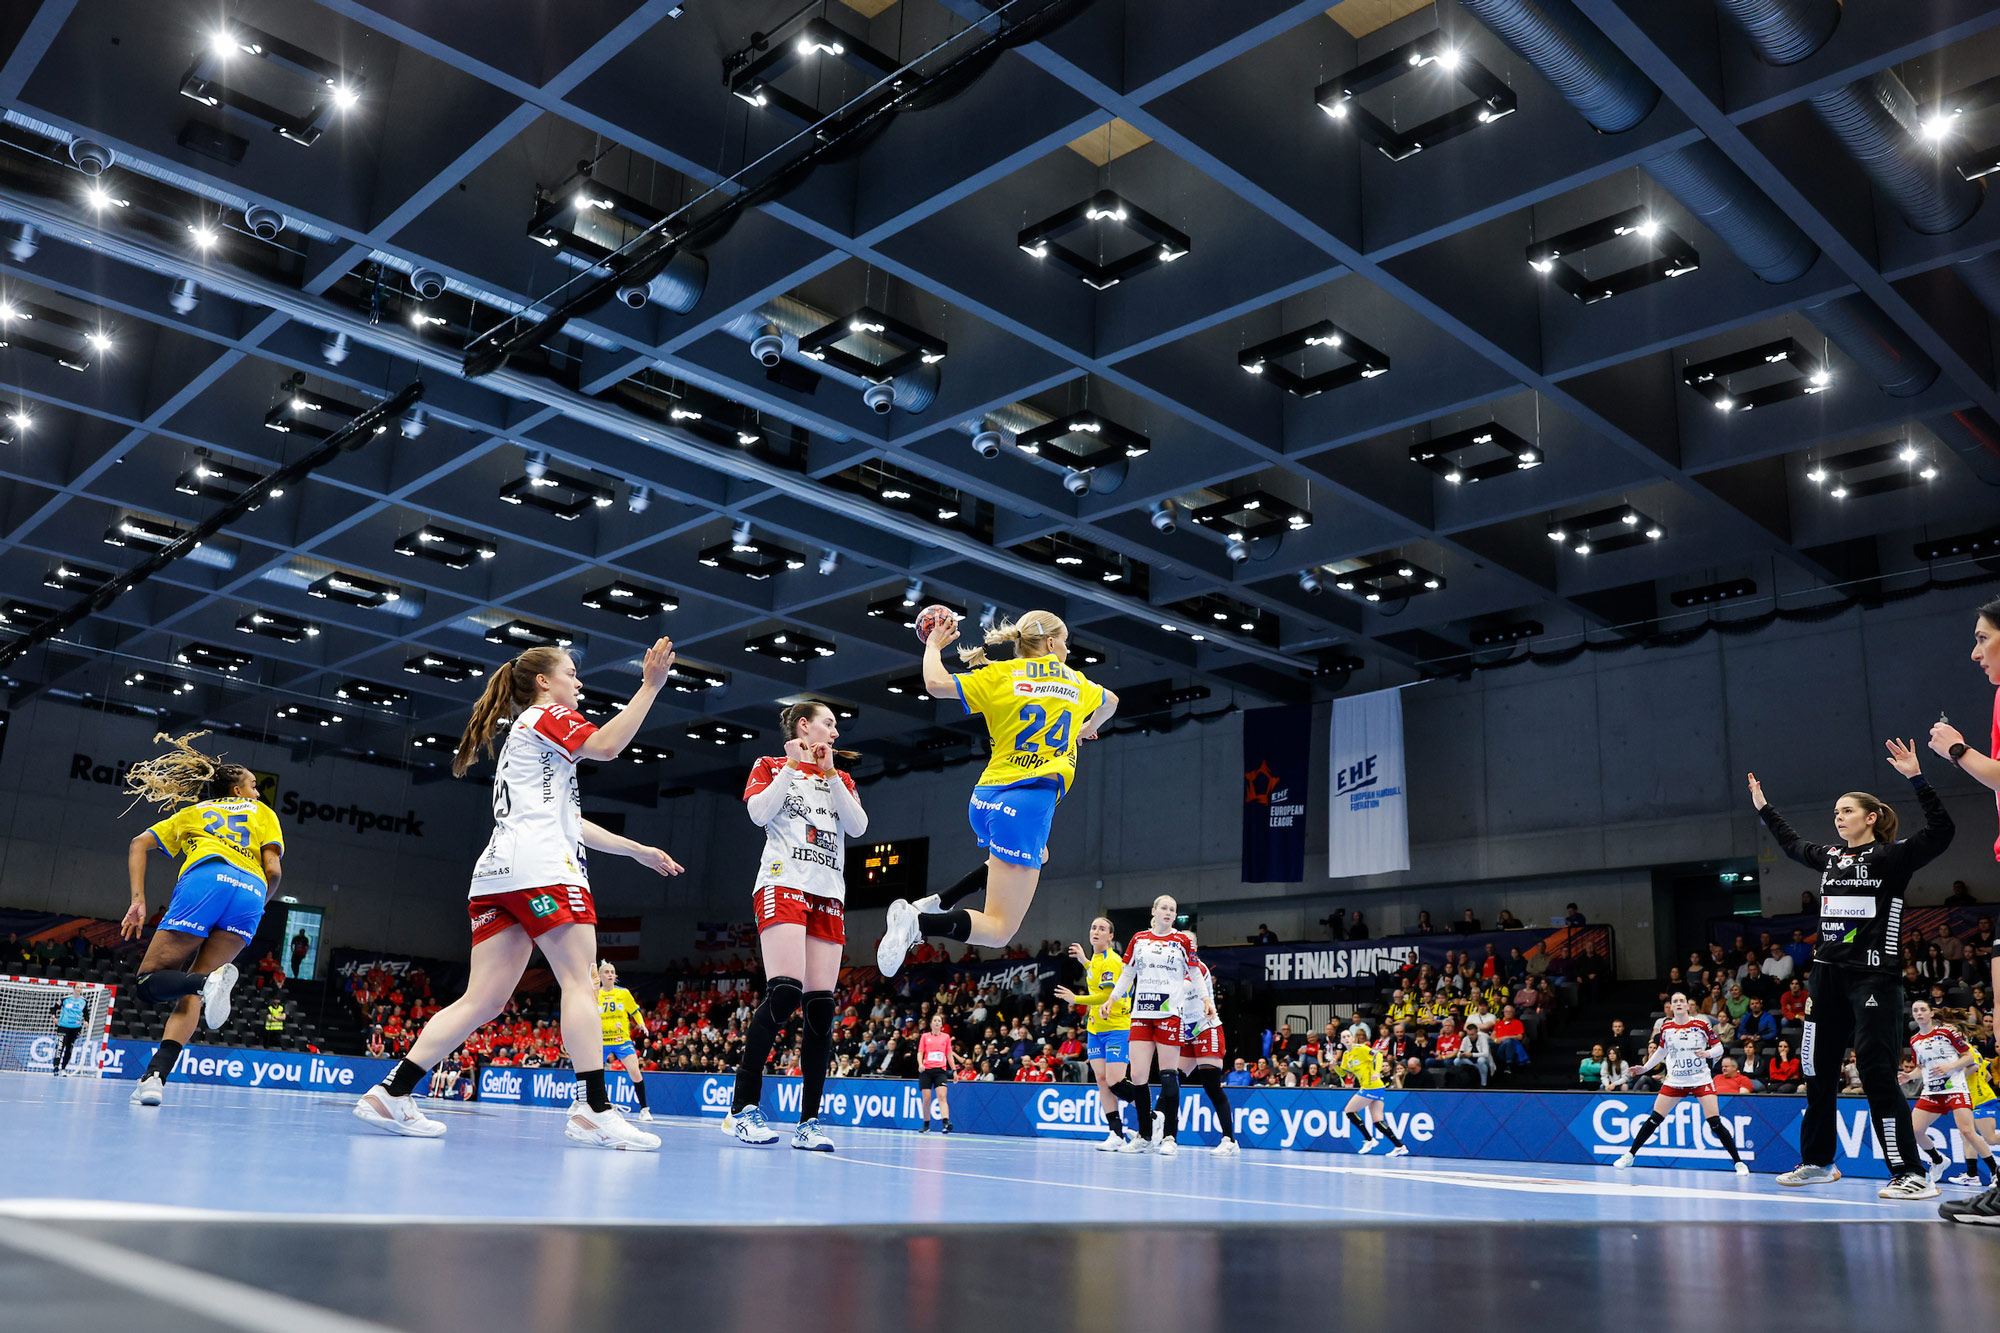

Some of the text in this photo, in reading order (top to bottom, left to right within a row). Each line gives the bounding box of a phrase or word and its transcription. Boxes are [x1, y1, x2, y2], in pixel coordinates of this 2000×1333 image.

[1014, 704, 1072, 757] 24
[540, 751, 555, 804] Sydbank
[1337, 754, 1377, 791] EHF
[1271, 789, 1288, 801] EHF
[281, 790, 424, 838] Sportpark
[815, 807, 827, 815] dk
[1003, 806, 1017, 817] as
[1270, 805, 1304, 817] EUROPEAN
[202, 810, 251, 848] 25
[1269, 816, 1293, 827] LEAGUE
[1021, 852, 1032, 860] as
[498, 867, 510, 875] A/S
[1855, 865, 1868, 878] 16
[1835, 879, 1882, 888] company
[532, 895, 551, 912] GF
[1294, 949, 1349, 981] FINALS
[1866, 949, 1880, 967] 16
[602, 1001, 616, 1012] 79
[1673, 1057, 1702, 1069] AUBO
[250, 1061, 302, 1086] you
[309, 1059, 355, 1086] live
[482, 1070, 523, 1094] Gerflor
[533, 1073, 578, 1100] Where
[852, 1094, 897, 1125] you
[1280, 1108, 1350, 1148] you
